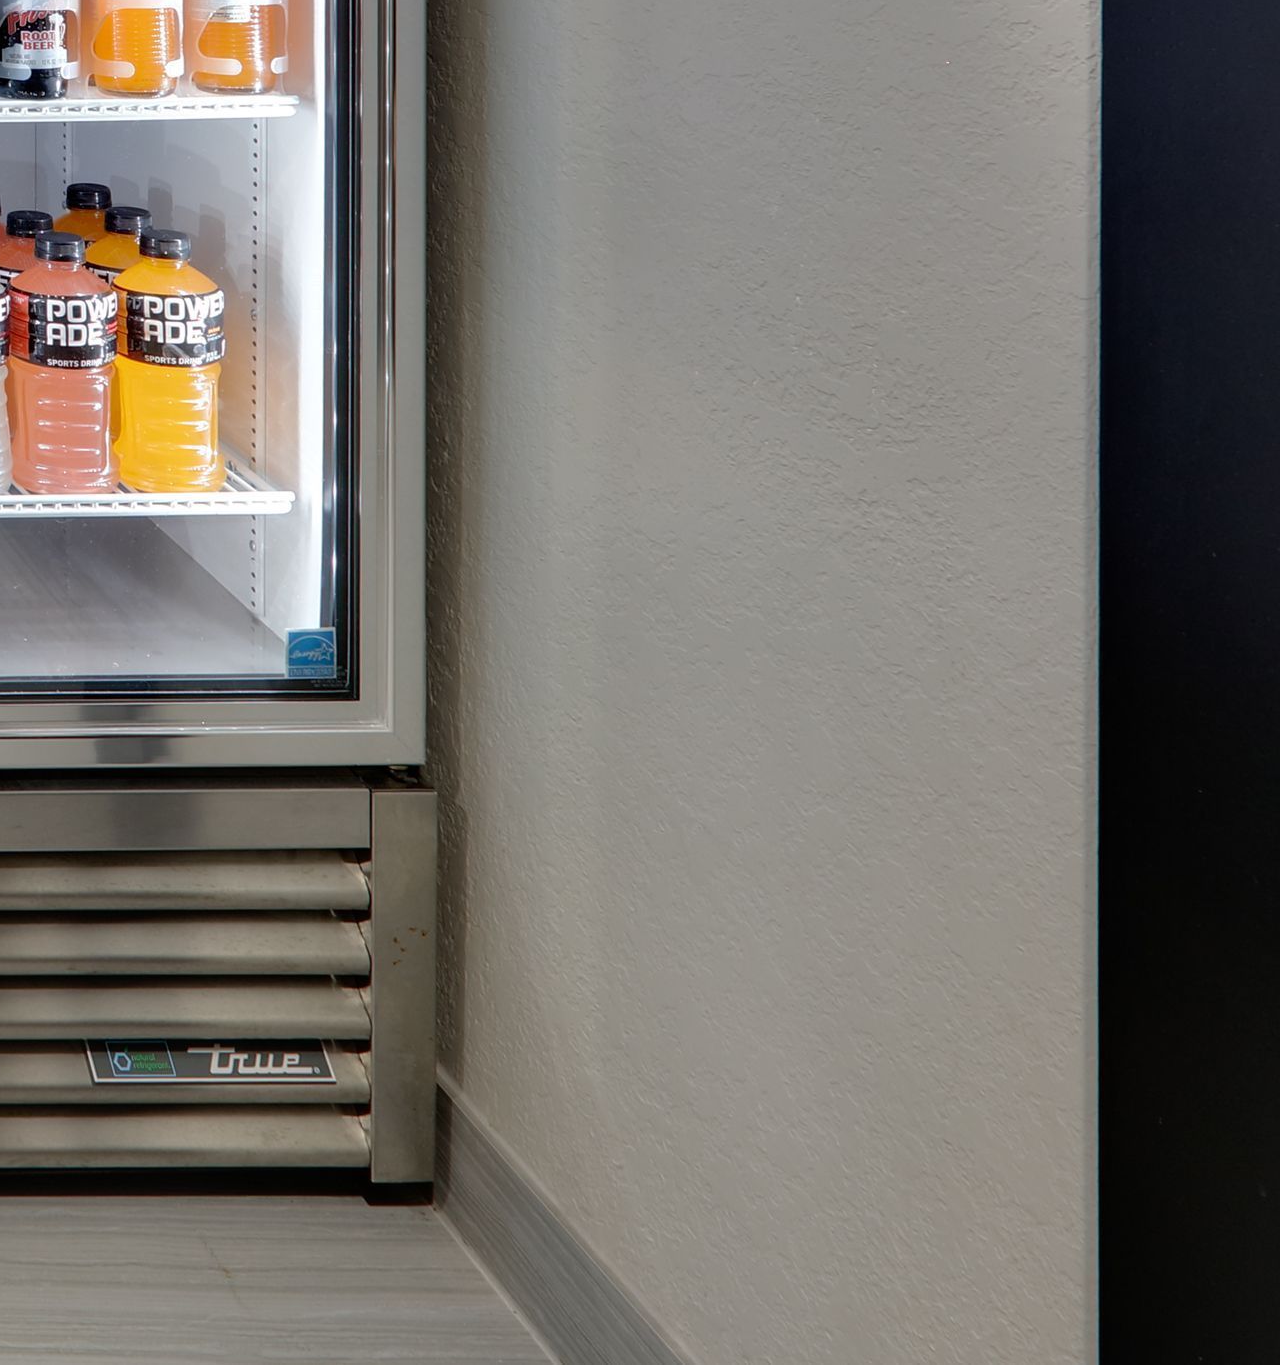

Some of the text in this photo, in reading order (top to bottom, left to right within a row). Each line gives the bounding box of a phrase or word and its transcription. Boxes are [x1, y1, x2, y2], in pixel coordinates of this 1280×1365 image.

[22, 32, 55, 41] ROOT
[23, 41, 54, 50] BEER
[46, 291, 118, 323] POWE
[47, 358, 80, 368] SPORTS
[144, 354, 177, 365] SPORTS
[188, 1043, 313, 1074] true
